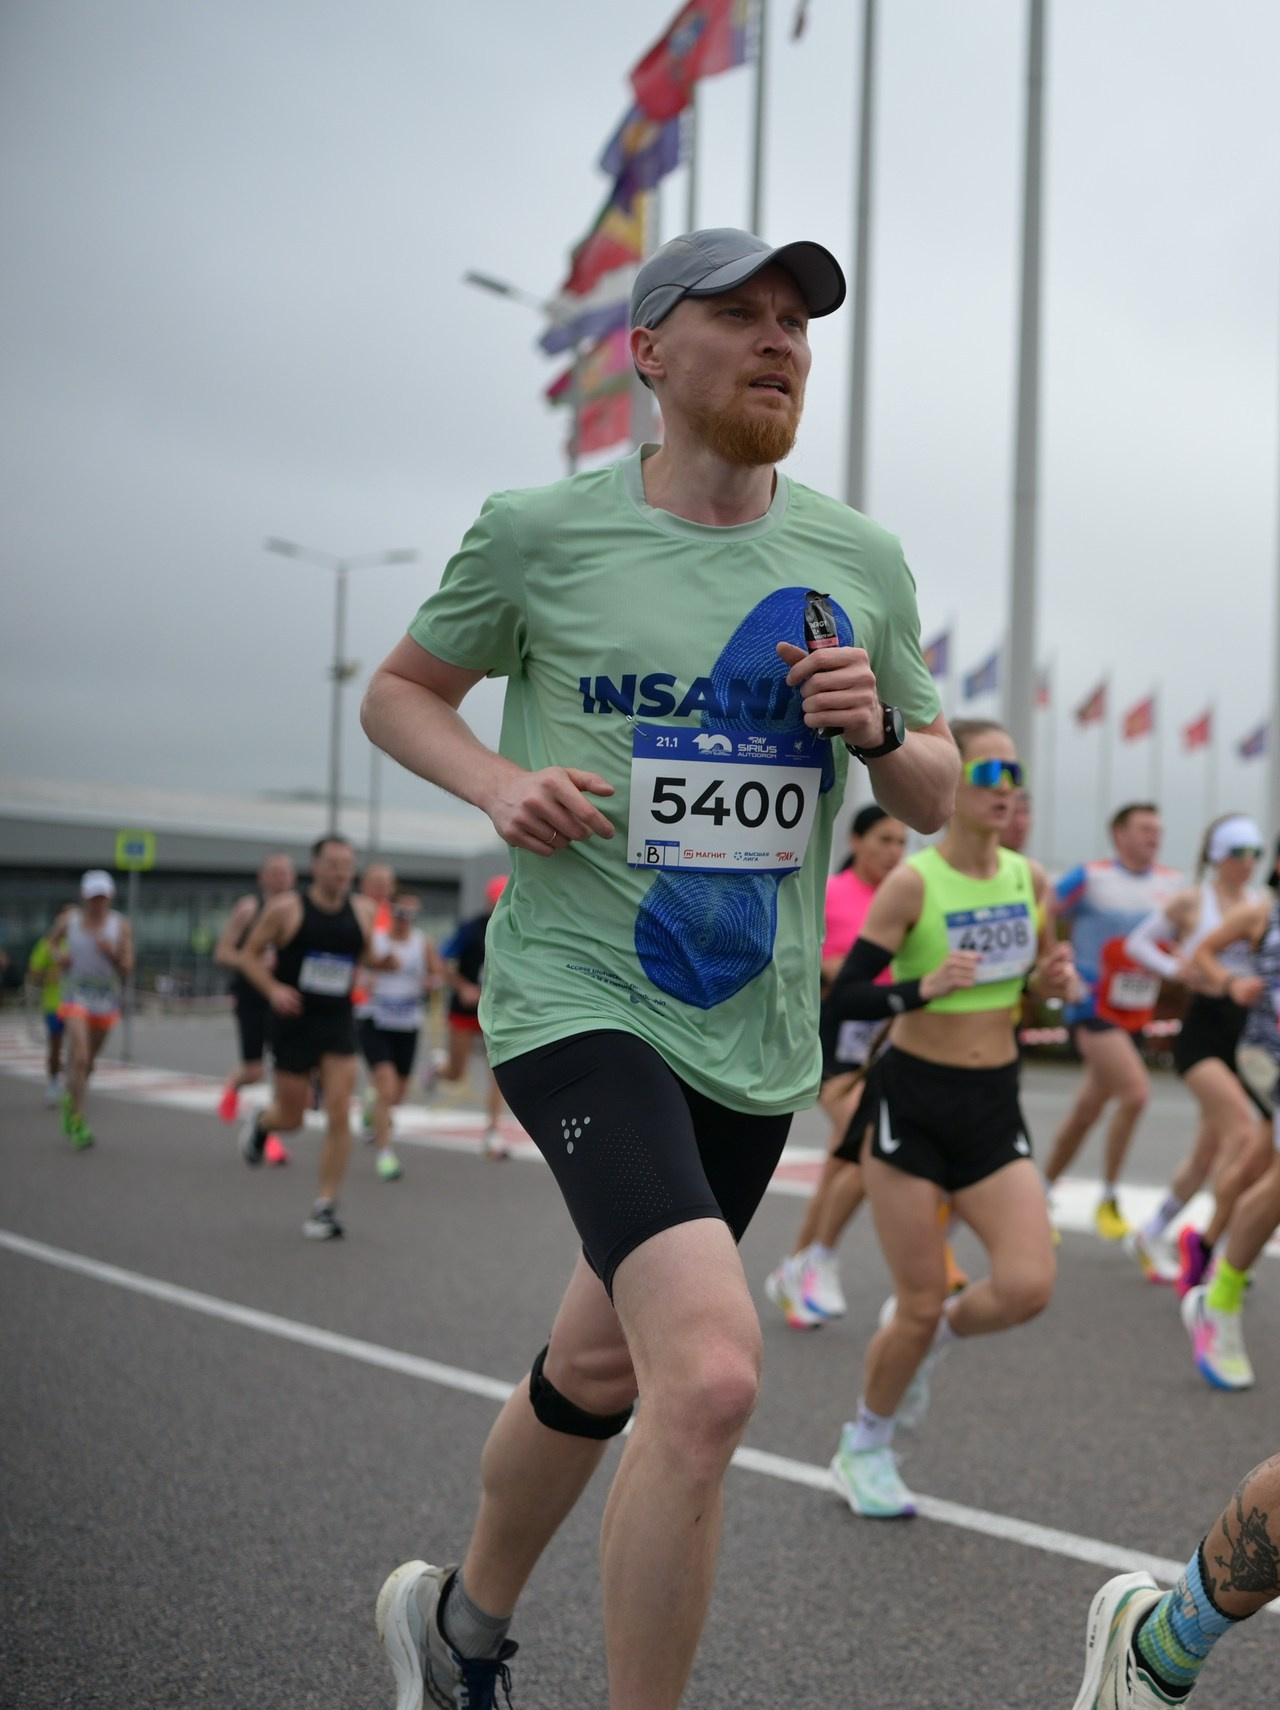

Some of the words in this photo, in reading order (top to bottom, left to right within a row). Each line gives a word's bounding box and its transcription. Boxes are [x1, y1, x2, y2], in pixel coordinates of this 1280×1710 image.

[656, 736, 678, 748] 21.1
[747, 736, 767, 745] RAY
[737, 743, 778, 754] SIRIUS
[650, 776, 805, 829] 5400
[695, 851, 727, 859] МАГНИТ
[775, 851, 795, 862] RAY
[959, 920, 1030, 953] 4208
